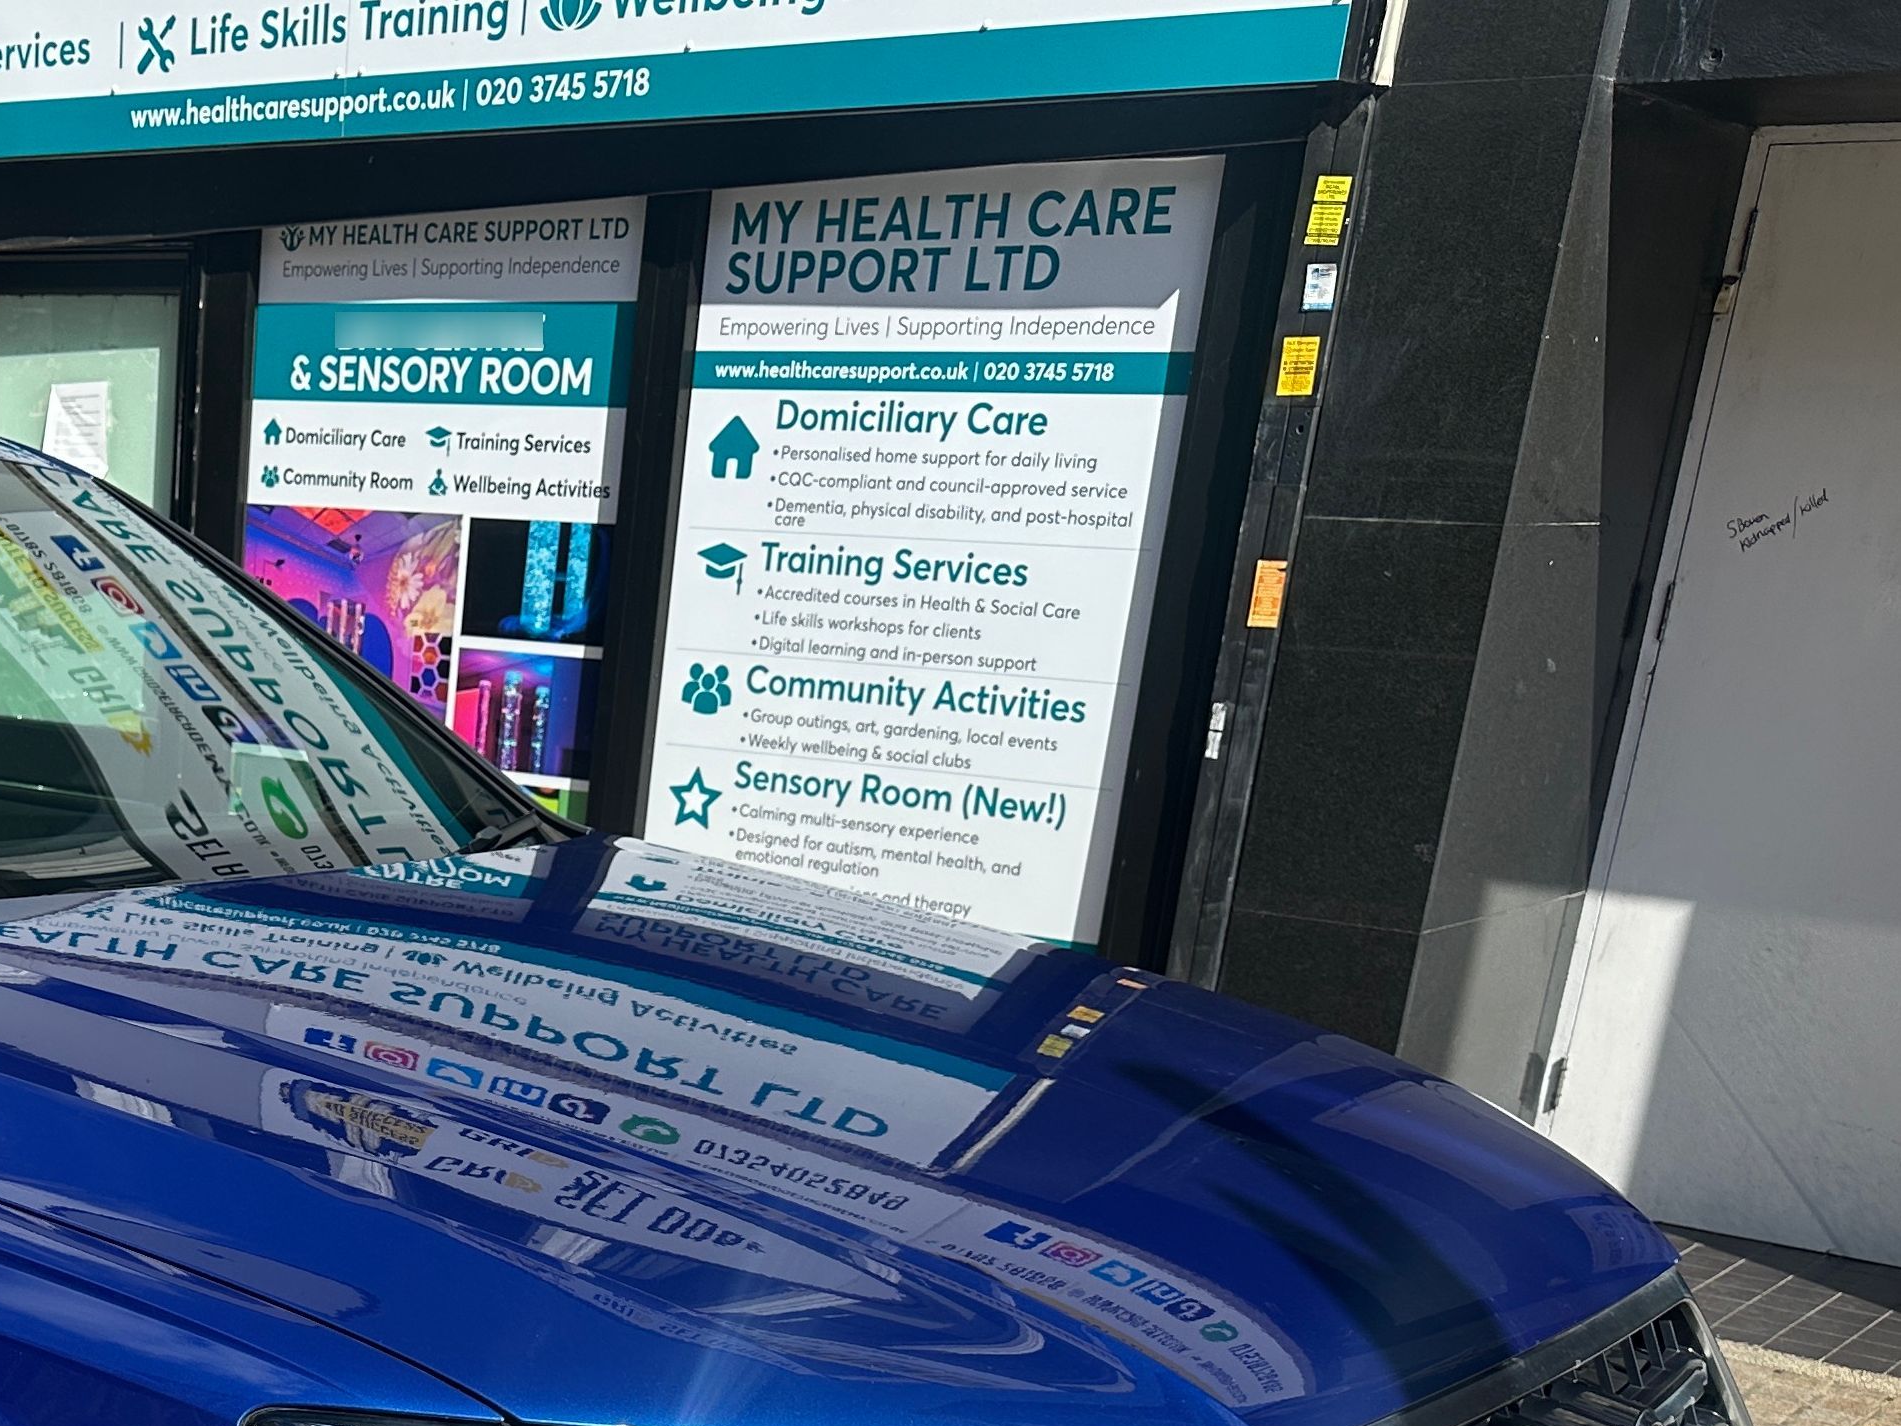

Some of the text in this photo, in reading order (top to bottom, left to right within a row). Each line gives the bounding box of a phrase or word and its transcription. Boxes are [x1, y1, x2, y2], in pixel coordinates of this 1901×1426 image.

[190, 0, 509, 56] Life Skills Training
[130, 67, 650, 129] www.healthcaresupport.co.uk 020 3745 5718
[309, 216, 629, 247] MY HEALTH CARE SUPPORT LTD
[731, 186, 1177, 246] MY HEALTH CARE
[282, 255, 620, 281] Empowering Lives Supporting Independence
[725, 244, 1060, 296] SUPPORT LTD
[719, 314, 1156, 341] Empowering Lives Supporting Independence
[290, 354, 594, 396] & SENSORY ROOM
[715, 360, 1115, 384] www.healthcaresupport.co.uk 020 3745 5718
[776, 399, 1049, 443] Domiciliary Care
[285, 427, 406, 451] Domiciliary Care
[457, 431, 591, 455] Training Services
[781, 445, 1098, 474] Personalised home support for daily living
[283, 468, 413, 493] Community Room
[454, 473, 611, 500] Wellbeing Activities
[778, 471, 1128, 501] CQC-compliant and council-approved service
[774, 497, 1133, 530] Dementia, physical disability, and post-hospital
[774, 513, 806, 528] care
[760, 541, 1029, 588] Training Services
[764, 585, 1081, 621] Accredited courses in Health & Social Care
[762, 610, 982, 642] Life skills workshops for clients
[759, 635, 1037, 672] Digital learning and in-person support
[746, 664, 1087, 724] Community Activities
[750, 707, 1058, 753] Group outings, art, gardening, local events
[748, 732, 972, 770] Weekly wellbeing & social clubs
[734, 760, 1067, 831] Sensory Room (New!)
[739, 802, 980, 846] Calming multi-sensory experience
[735, 847, 880, 879] emotional regulation
[736, 827, 1021, 878] Designed for autism, mental health, and
[914, 893, 972, 918] therapy
